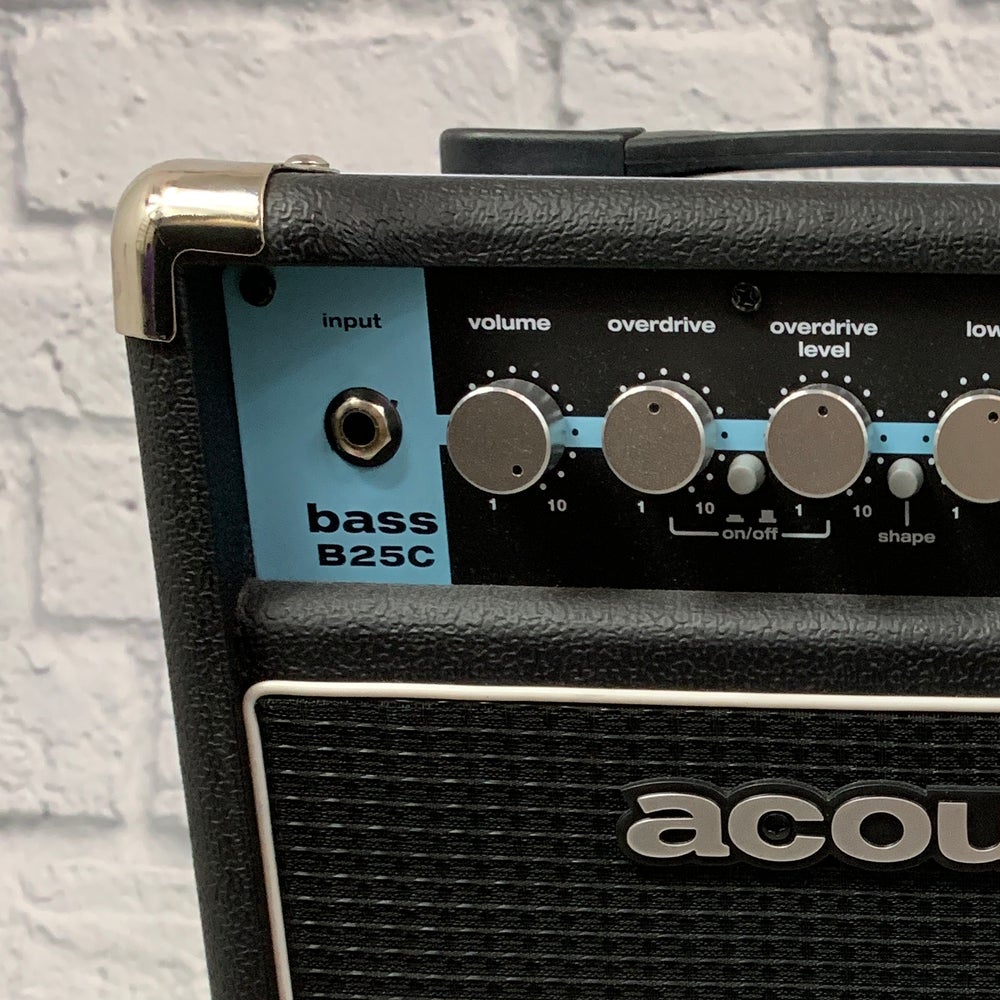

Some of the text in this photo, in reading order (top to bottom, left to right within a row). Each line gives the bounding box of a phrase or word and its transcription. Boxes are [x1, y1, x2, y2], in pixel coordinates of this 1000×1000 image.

[321, 312, 383, 332] input
[468, 313, 552, 331] volume
[607, 316, 716, 334] overdrive
[769, 318, 879, 336] overdrive
[798, 340, 851, 358] level
[488, 497, 497, 511] 1
[547, 498, 567, 512] 10
[637, 500, 645, 514] 1
[695, 501, 715, 515] 10
[794, 503, 803, 517] 1
[853, 504, 872, 518] 10
[306, 502, 439, 535] bass
[951, 506, 959, 520] 1
[722, 526, 779, 541] on/off
[878, 529, 936, 546] shape
[317, 543, 436, 568] B25C
